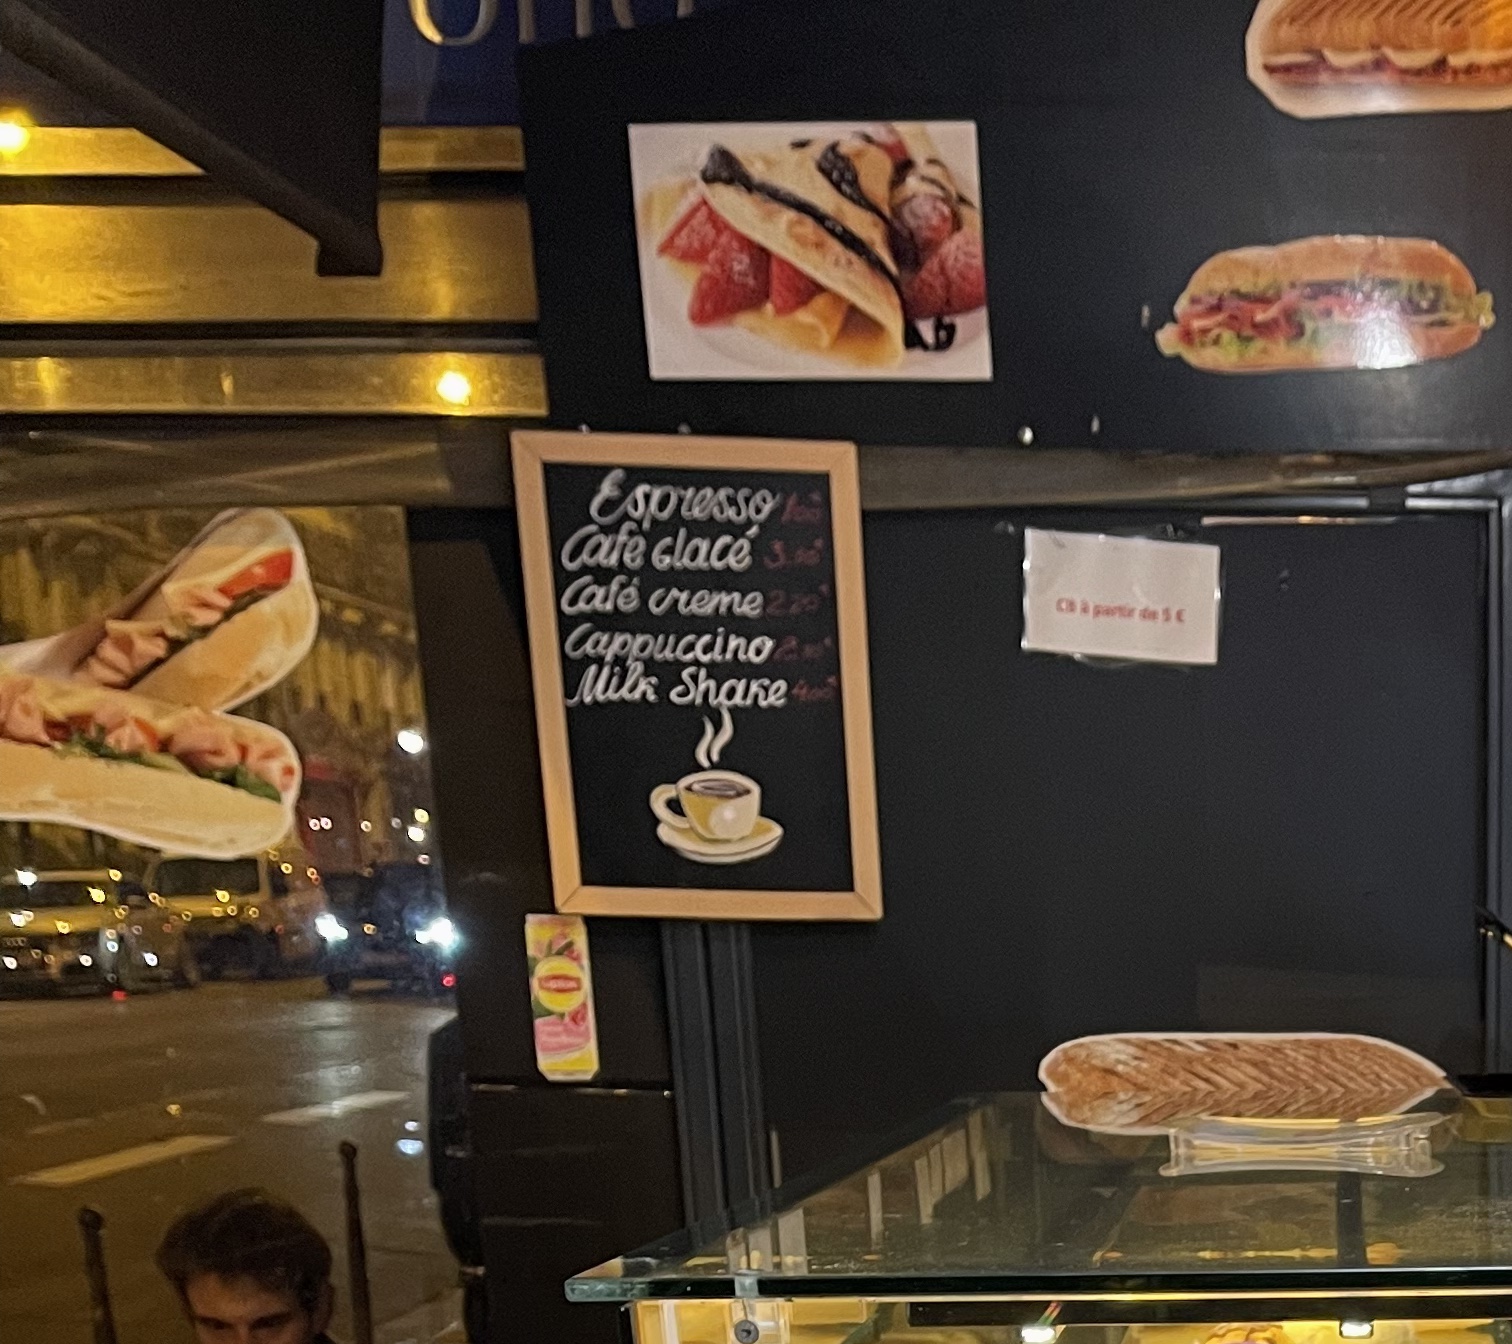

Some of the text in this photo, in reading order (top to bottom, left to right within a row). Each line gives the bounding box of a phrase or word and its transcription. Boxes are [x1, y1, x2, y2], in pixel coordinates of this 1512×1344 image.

[589, 468, 781, 532] Espresso
[560, 574, 641, 616] Café
[565, 622, 776, 668] Cappuccino
